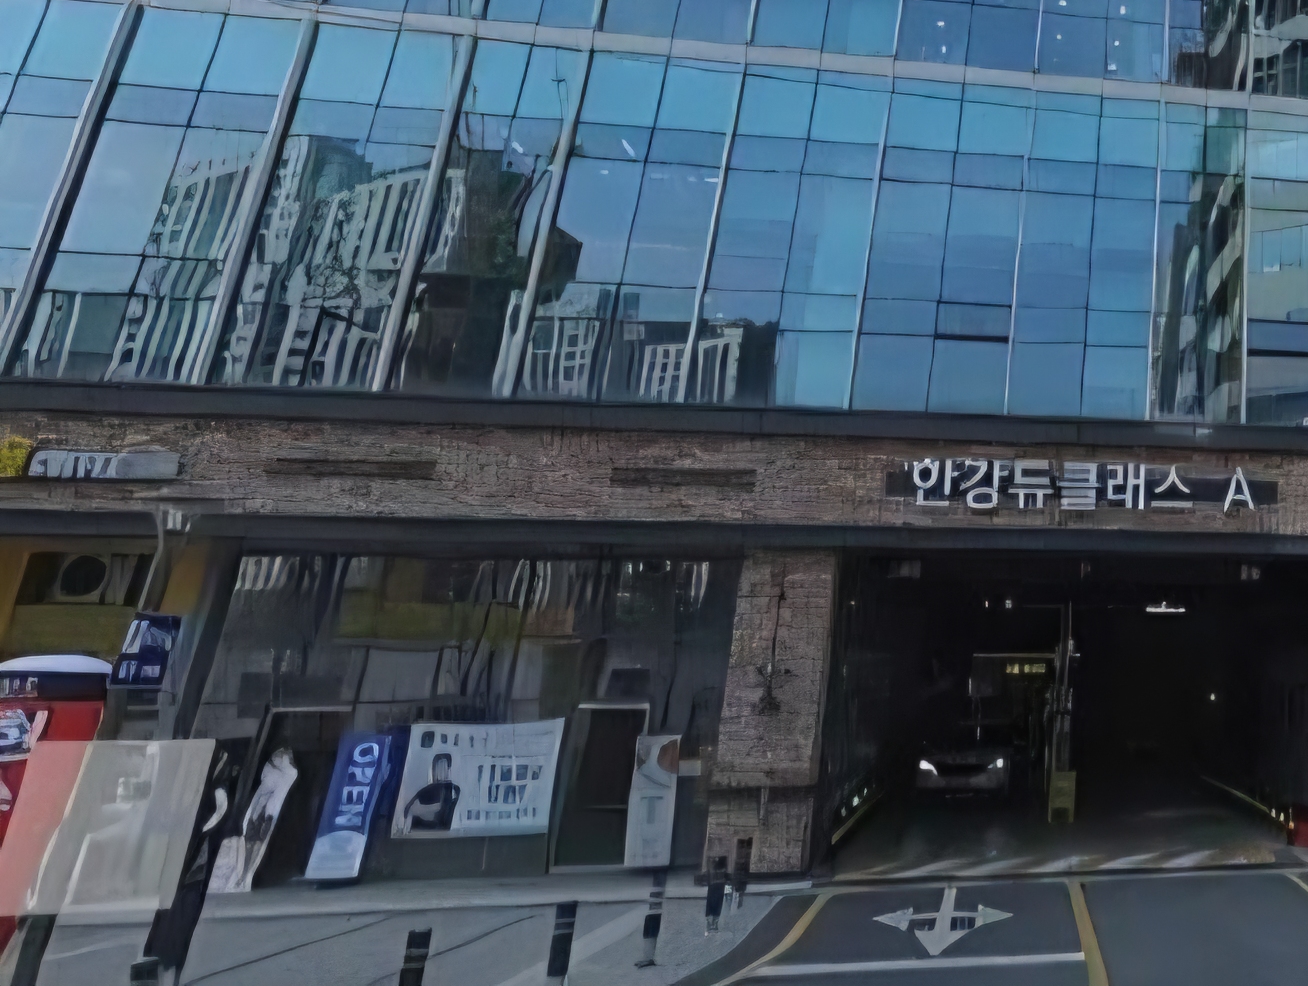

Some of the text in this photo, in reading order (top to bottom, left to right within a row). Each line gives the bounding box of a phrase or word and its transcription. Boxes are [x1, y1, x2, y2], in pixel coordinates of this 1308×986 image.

[911, 457, 1256, 514] 한강듀클래스 A
[334, 741, 380, 827] OPEN
